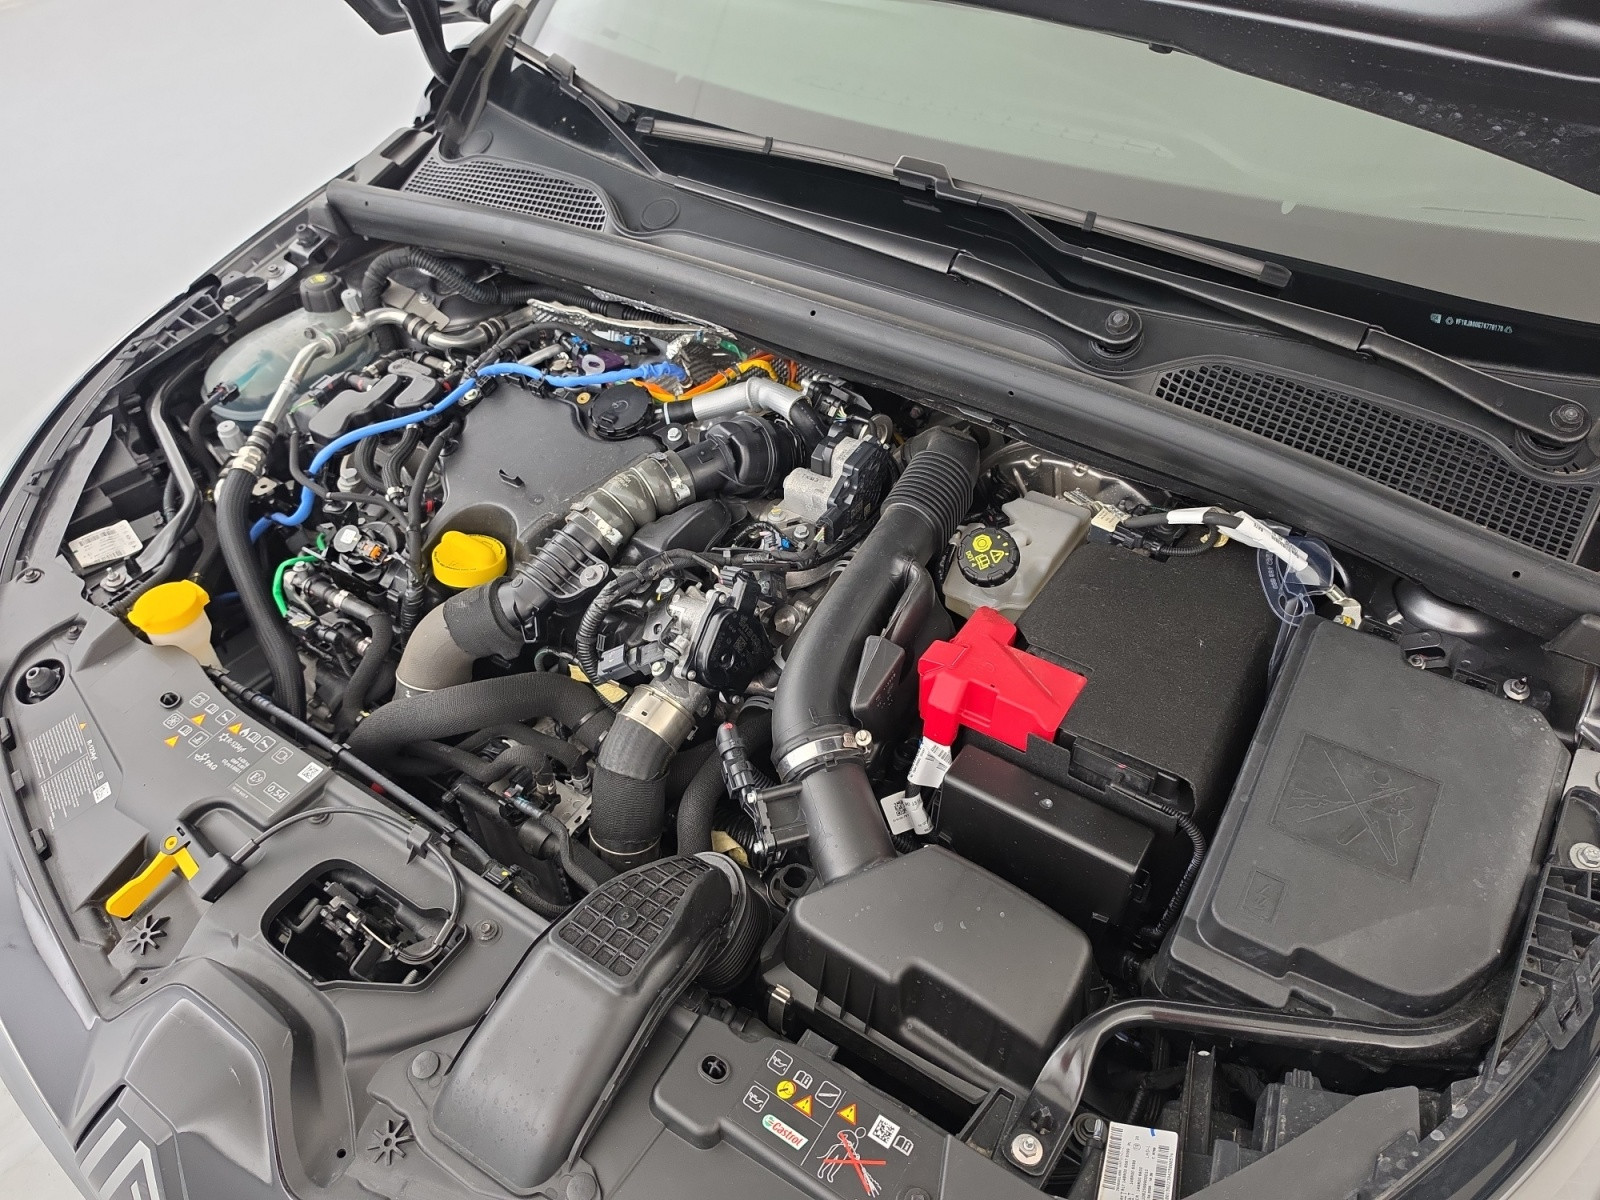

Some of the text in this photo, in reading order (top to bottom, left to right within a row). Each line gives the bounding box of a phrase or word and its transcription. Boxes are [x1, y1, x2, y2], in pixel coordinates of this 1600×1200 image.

[965, 550, 975, 562] DOT
[203, 759, 218, 771] PAG
[772, 1122, 804, 1147] Castrol
